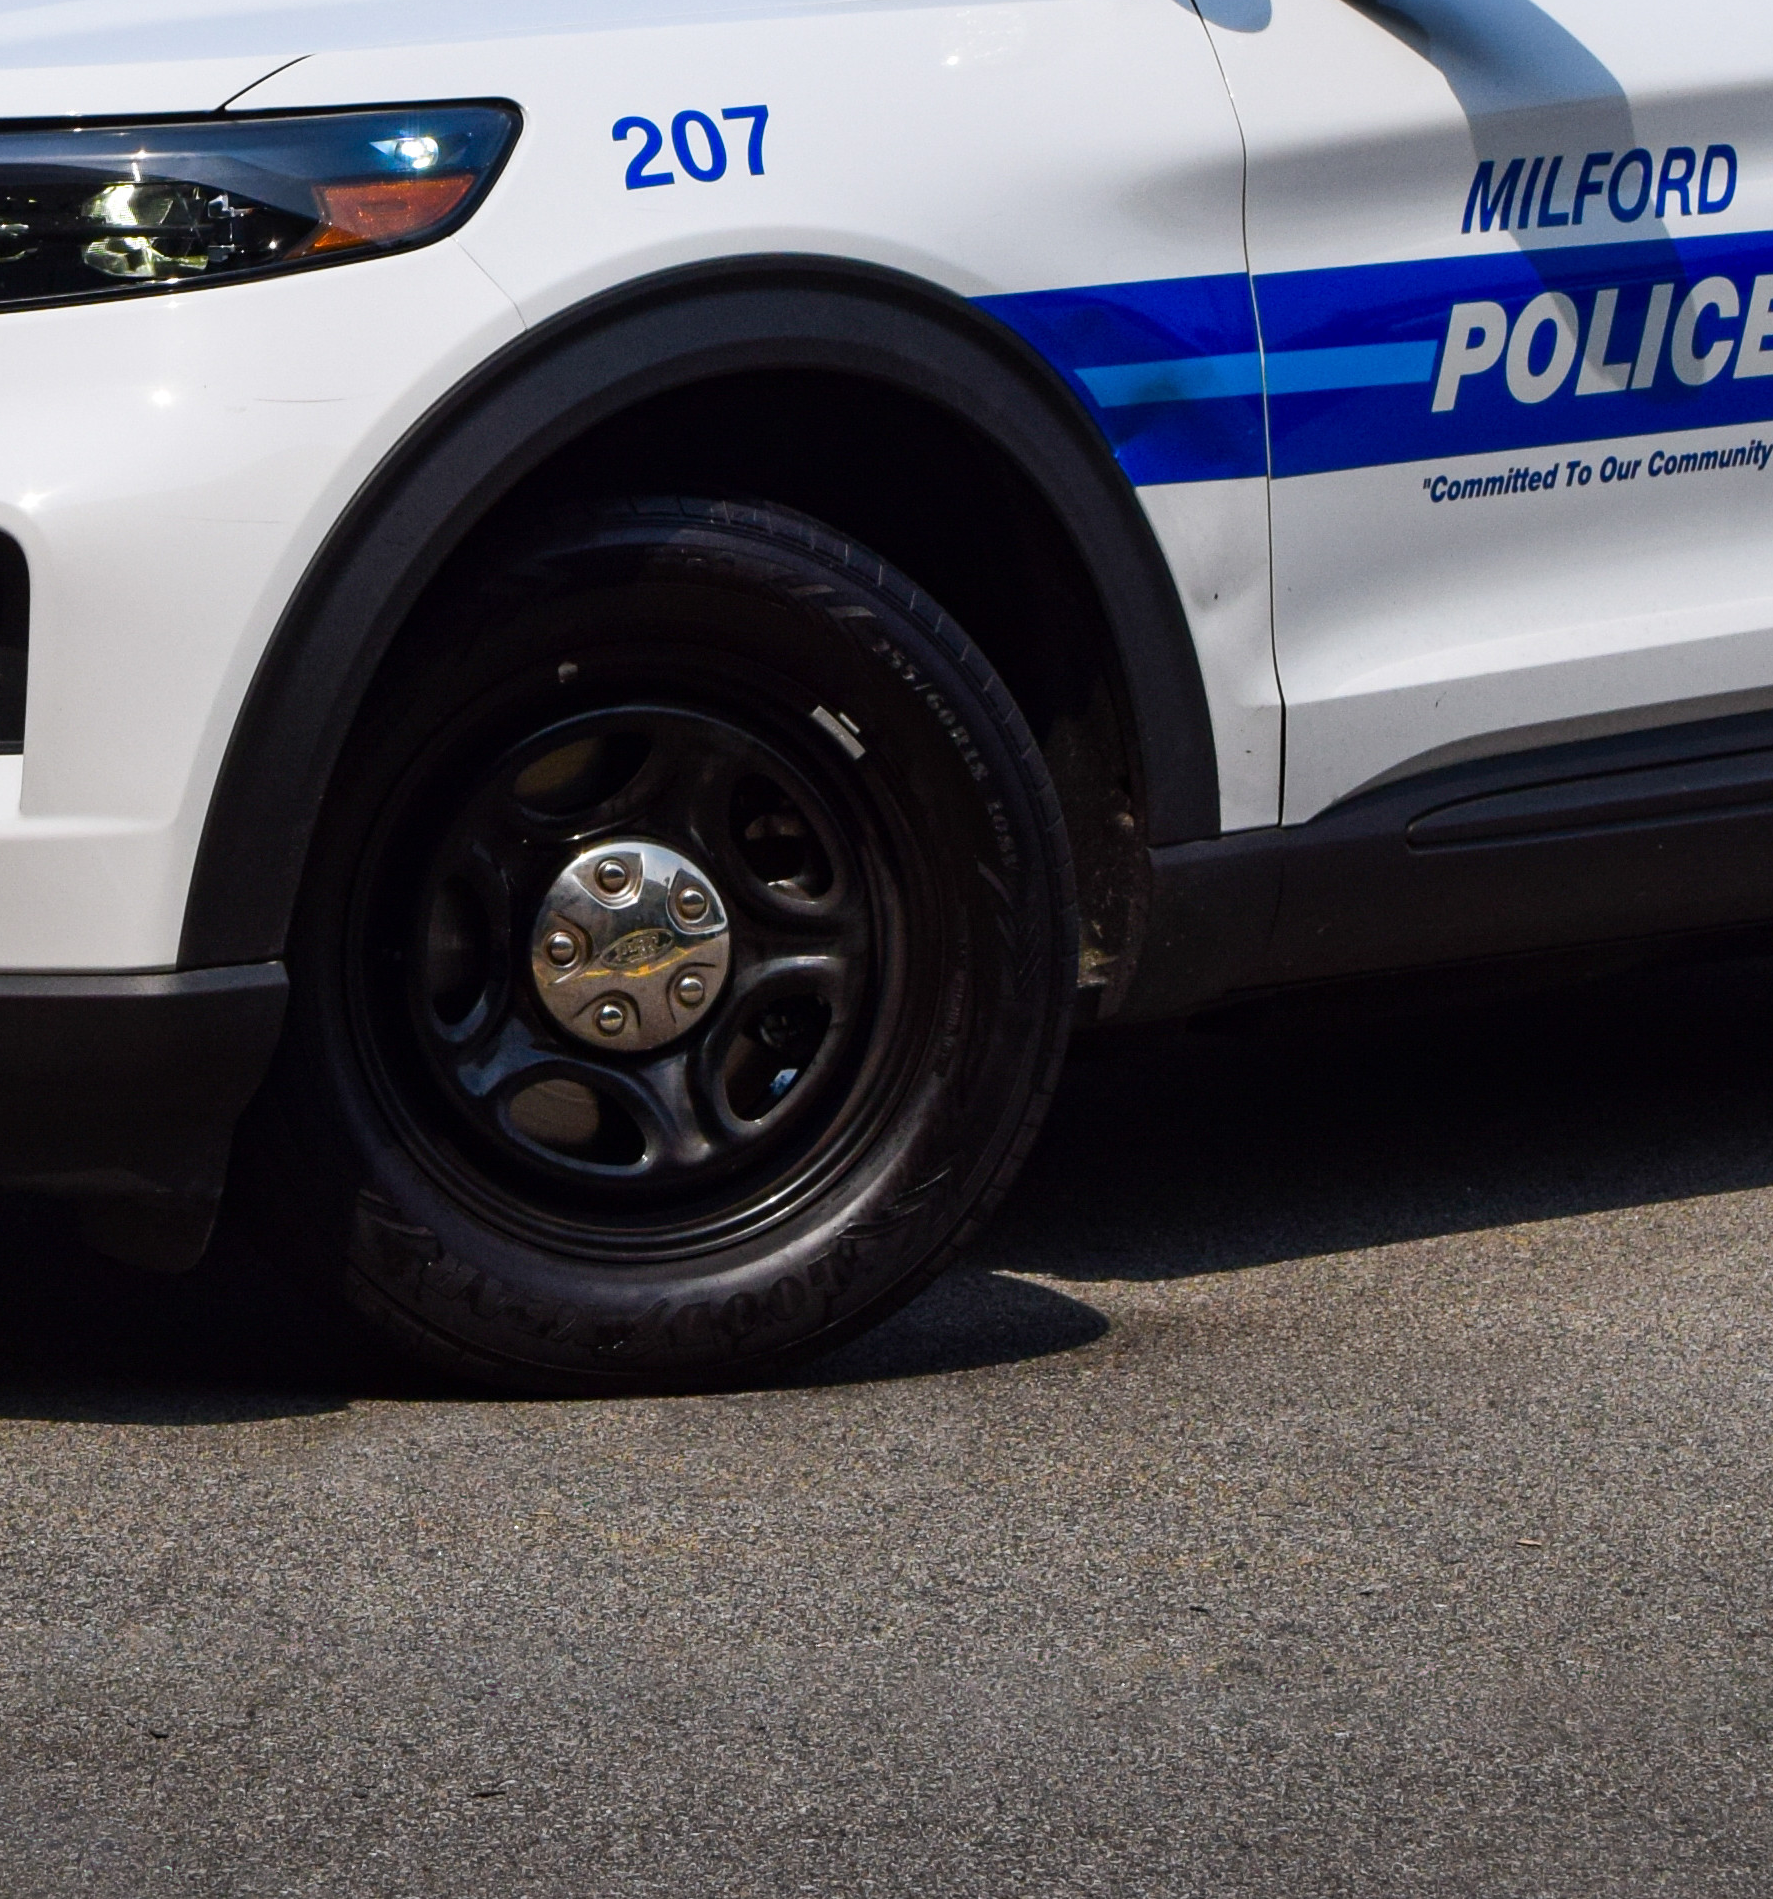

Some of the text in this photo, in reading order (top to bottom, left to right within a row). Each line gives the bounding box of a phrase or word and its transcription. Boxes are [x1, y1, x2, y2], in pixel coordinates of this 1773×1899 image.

[612, 105, 768, 190] 207
[1461, 143, 1738, 234] MILFORD
[1423, 463, 1560, 503] "Committed
[1566, 460, 1592, 486] To
[1600, 455, 1641, 483] Our
